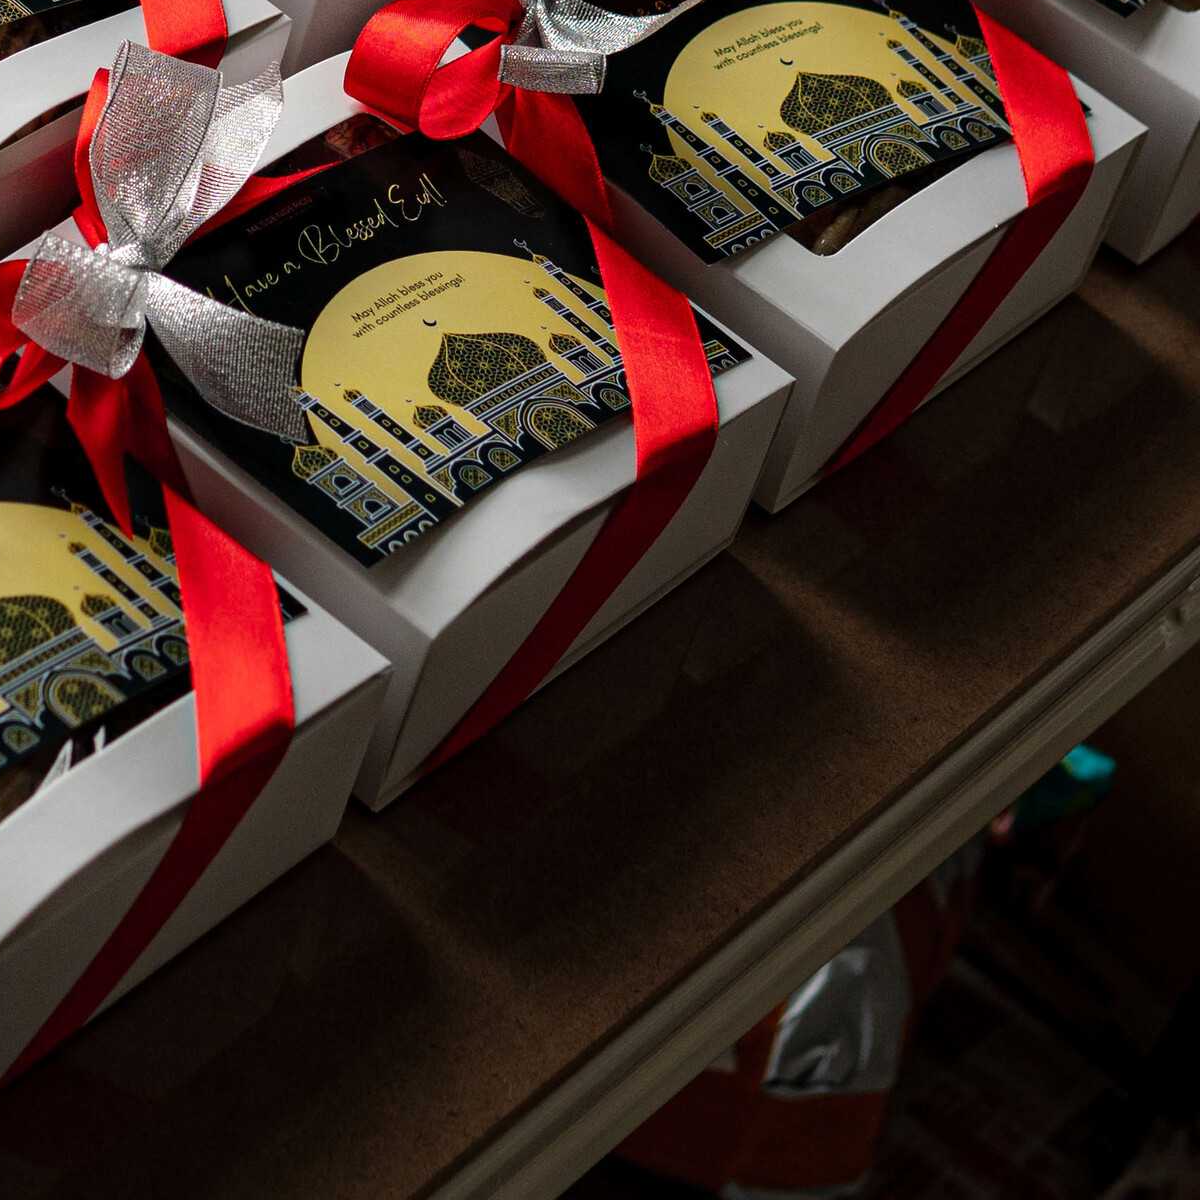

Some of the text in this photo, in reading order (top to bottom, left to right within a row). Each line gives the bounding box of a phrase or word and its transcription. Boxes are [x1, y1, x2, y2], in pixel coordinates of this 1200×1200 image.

[284, 260, 301, 274] a
[298, 198, 399, 265] Blessed
[388, 173, 448, 221] Eid!
[351, 271, 444, 323] May Allah bless you
[352, 273, 466, 338] with countless blessings!
